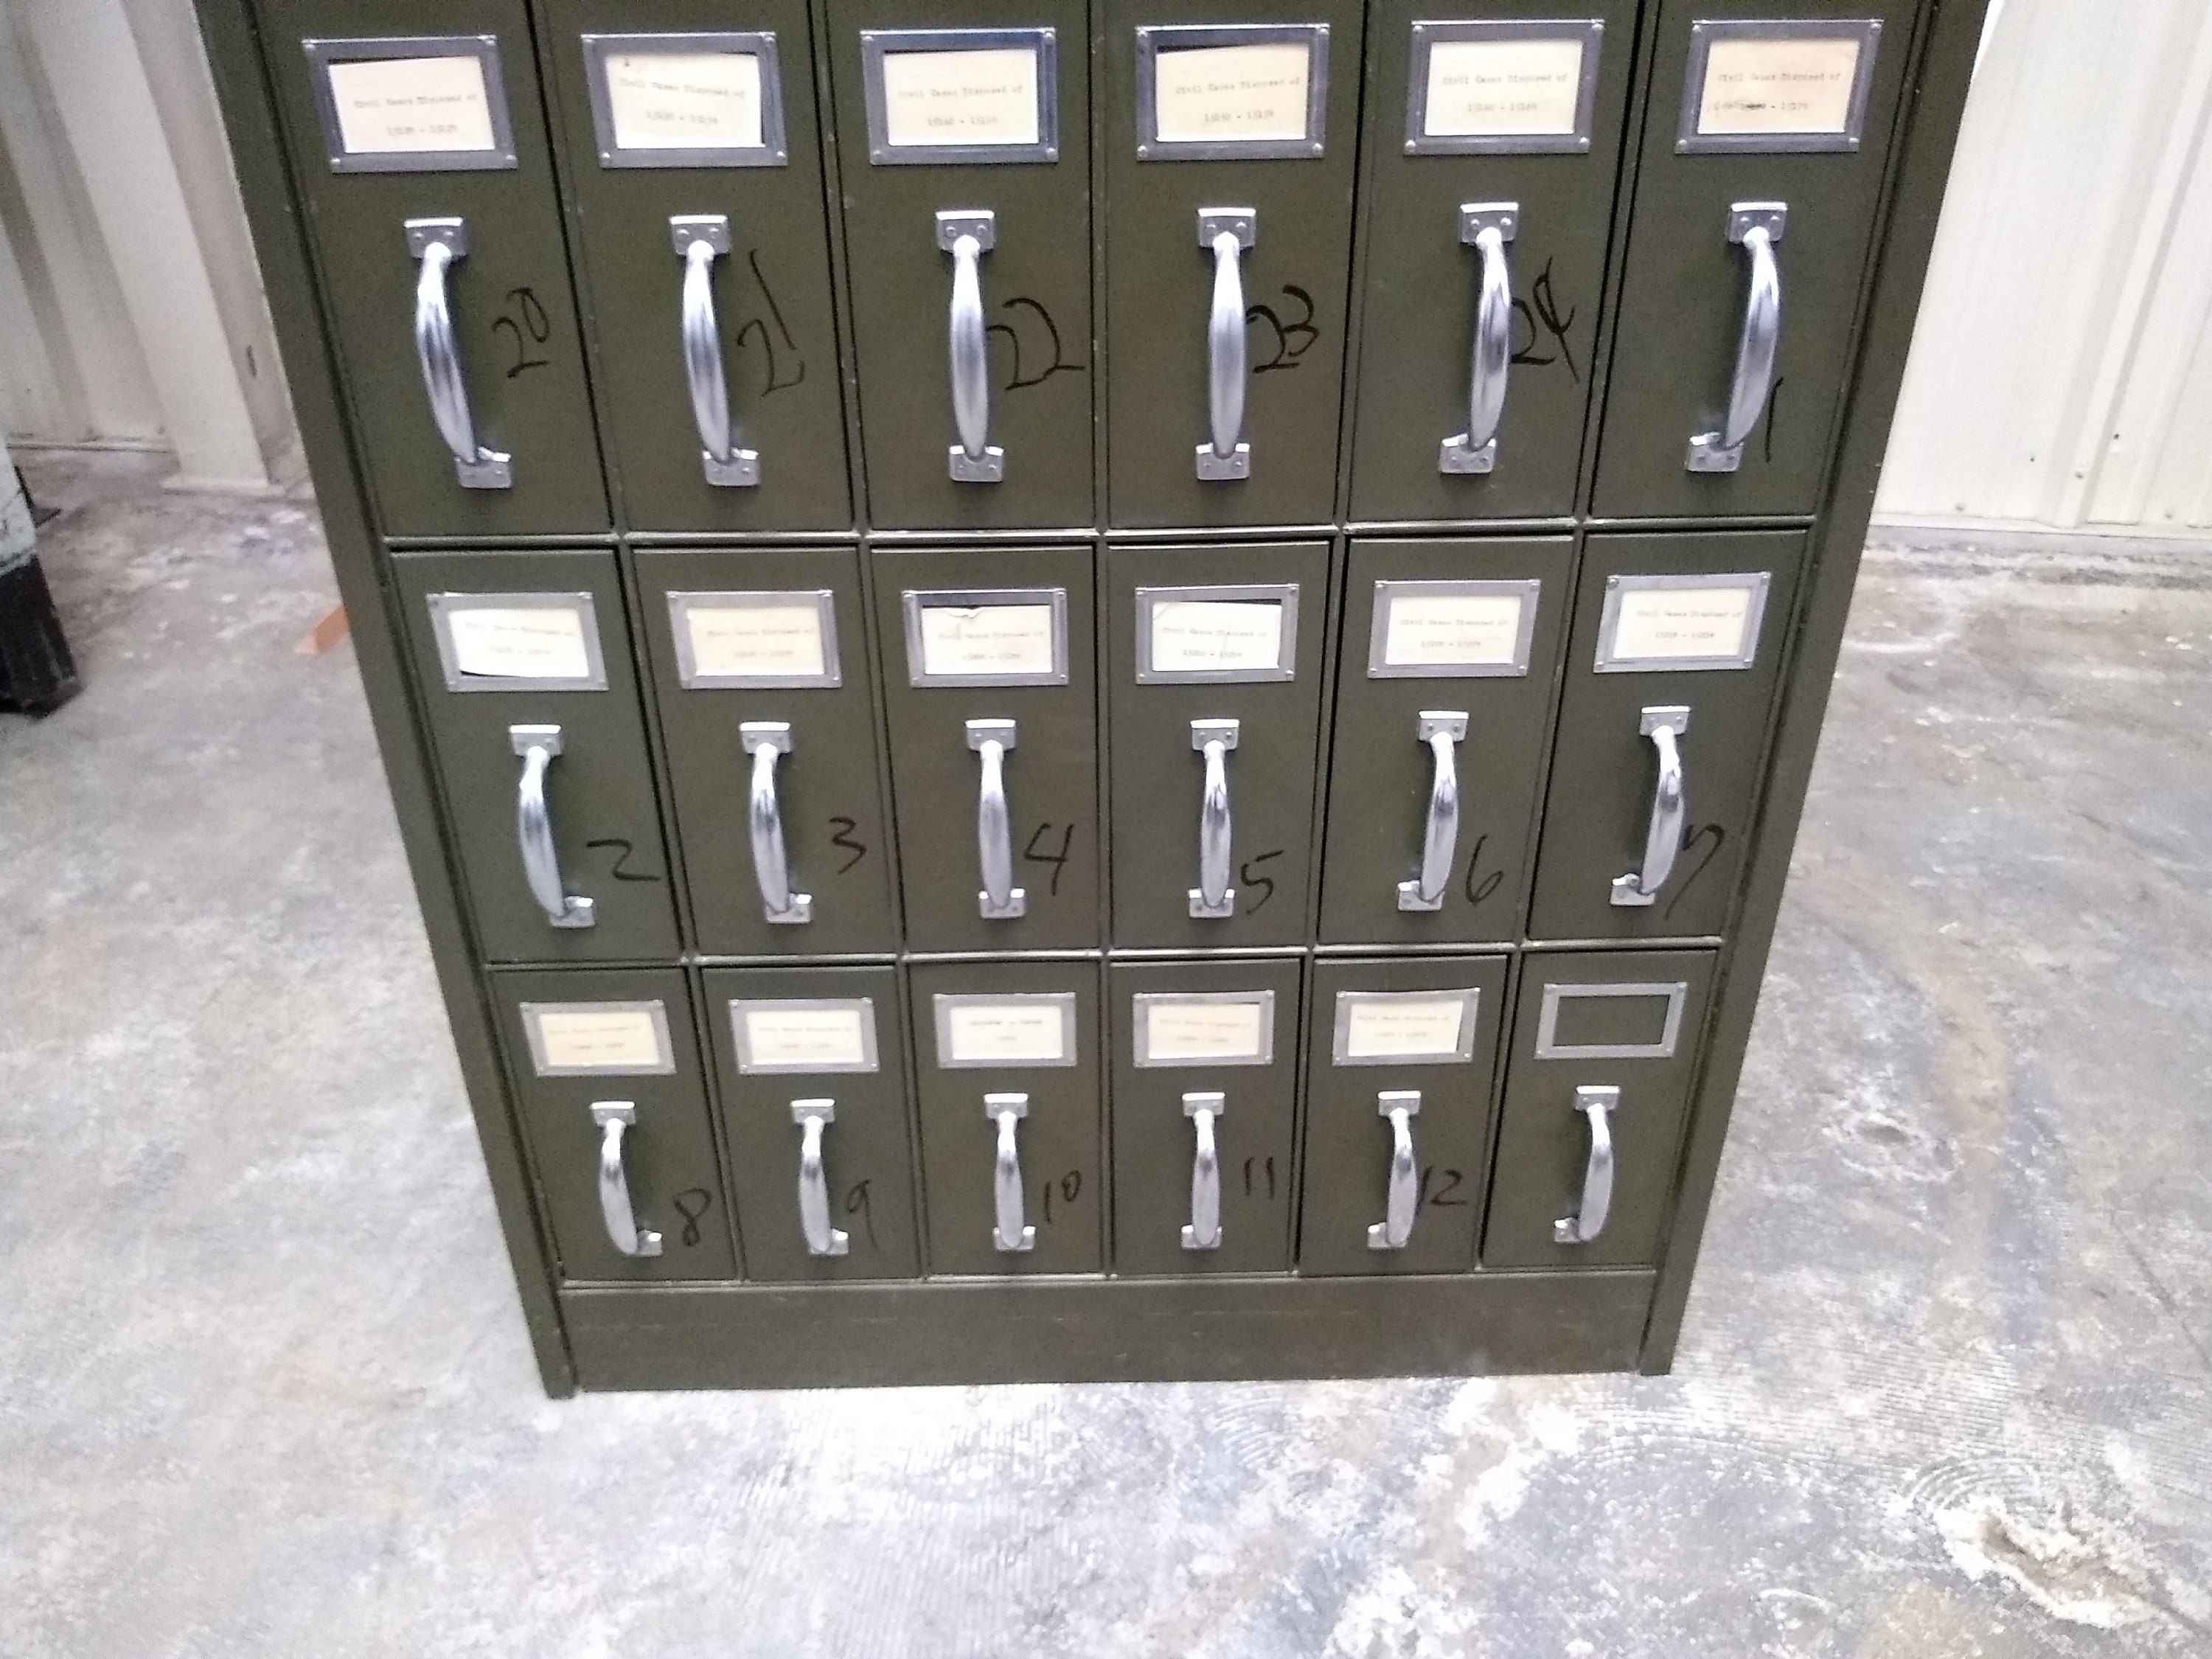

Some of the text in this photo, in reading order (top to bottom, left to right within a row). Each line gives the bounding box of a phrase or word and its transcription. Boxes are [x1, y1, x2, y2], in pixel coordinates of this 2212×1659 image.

[493, 287, 549, 378] 20
[737, 248, 805, 397] 21
[987, 298, 1085, 392] 22
[1245, 285, 1320, 374] 23
[1512, 256, 1580, 383] 24
[587, 839, 661, 881] 2
[830, 816, 867, 875] 3
[1024, 823, 1074, 897] 4
[1465, 834, 1503, 905] 6
[1664, 824, 1725, 920] 7
[1240, 849, 1284, 915] 5
[1043, 1170, 1082, 1224] 10
[1244, 1156, 1275, 1200] 11
[1416, 1166, 1467, 1216] 12
[672, 1188, 713, 1247] 8
[847, 1179, 880, 1250] 9
